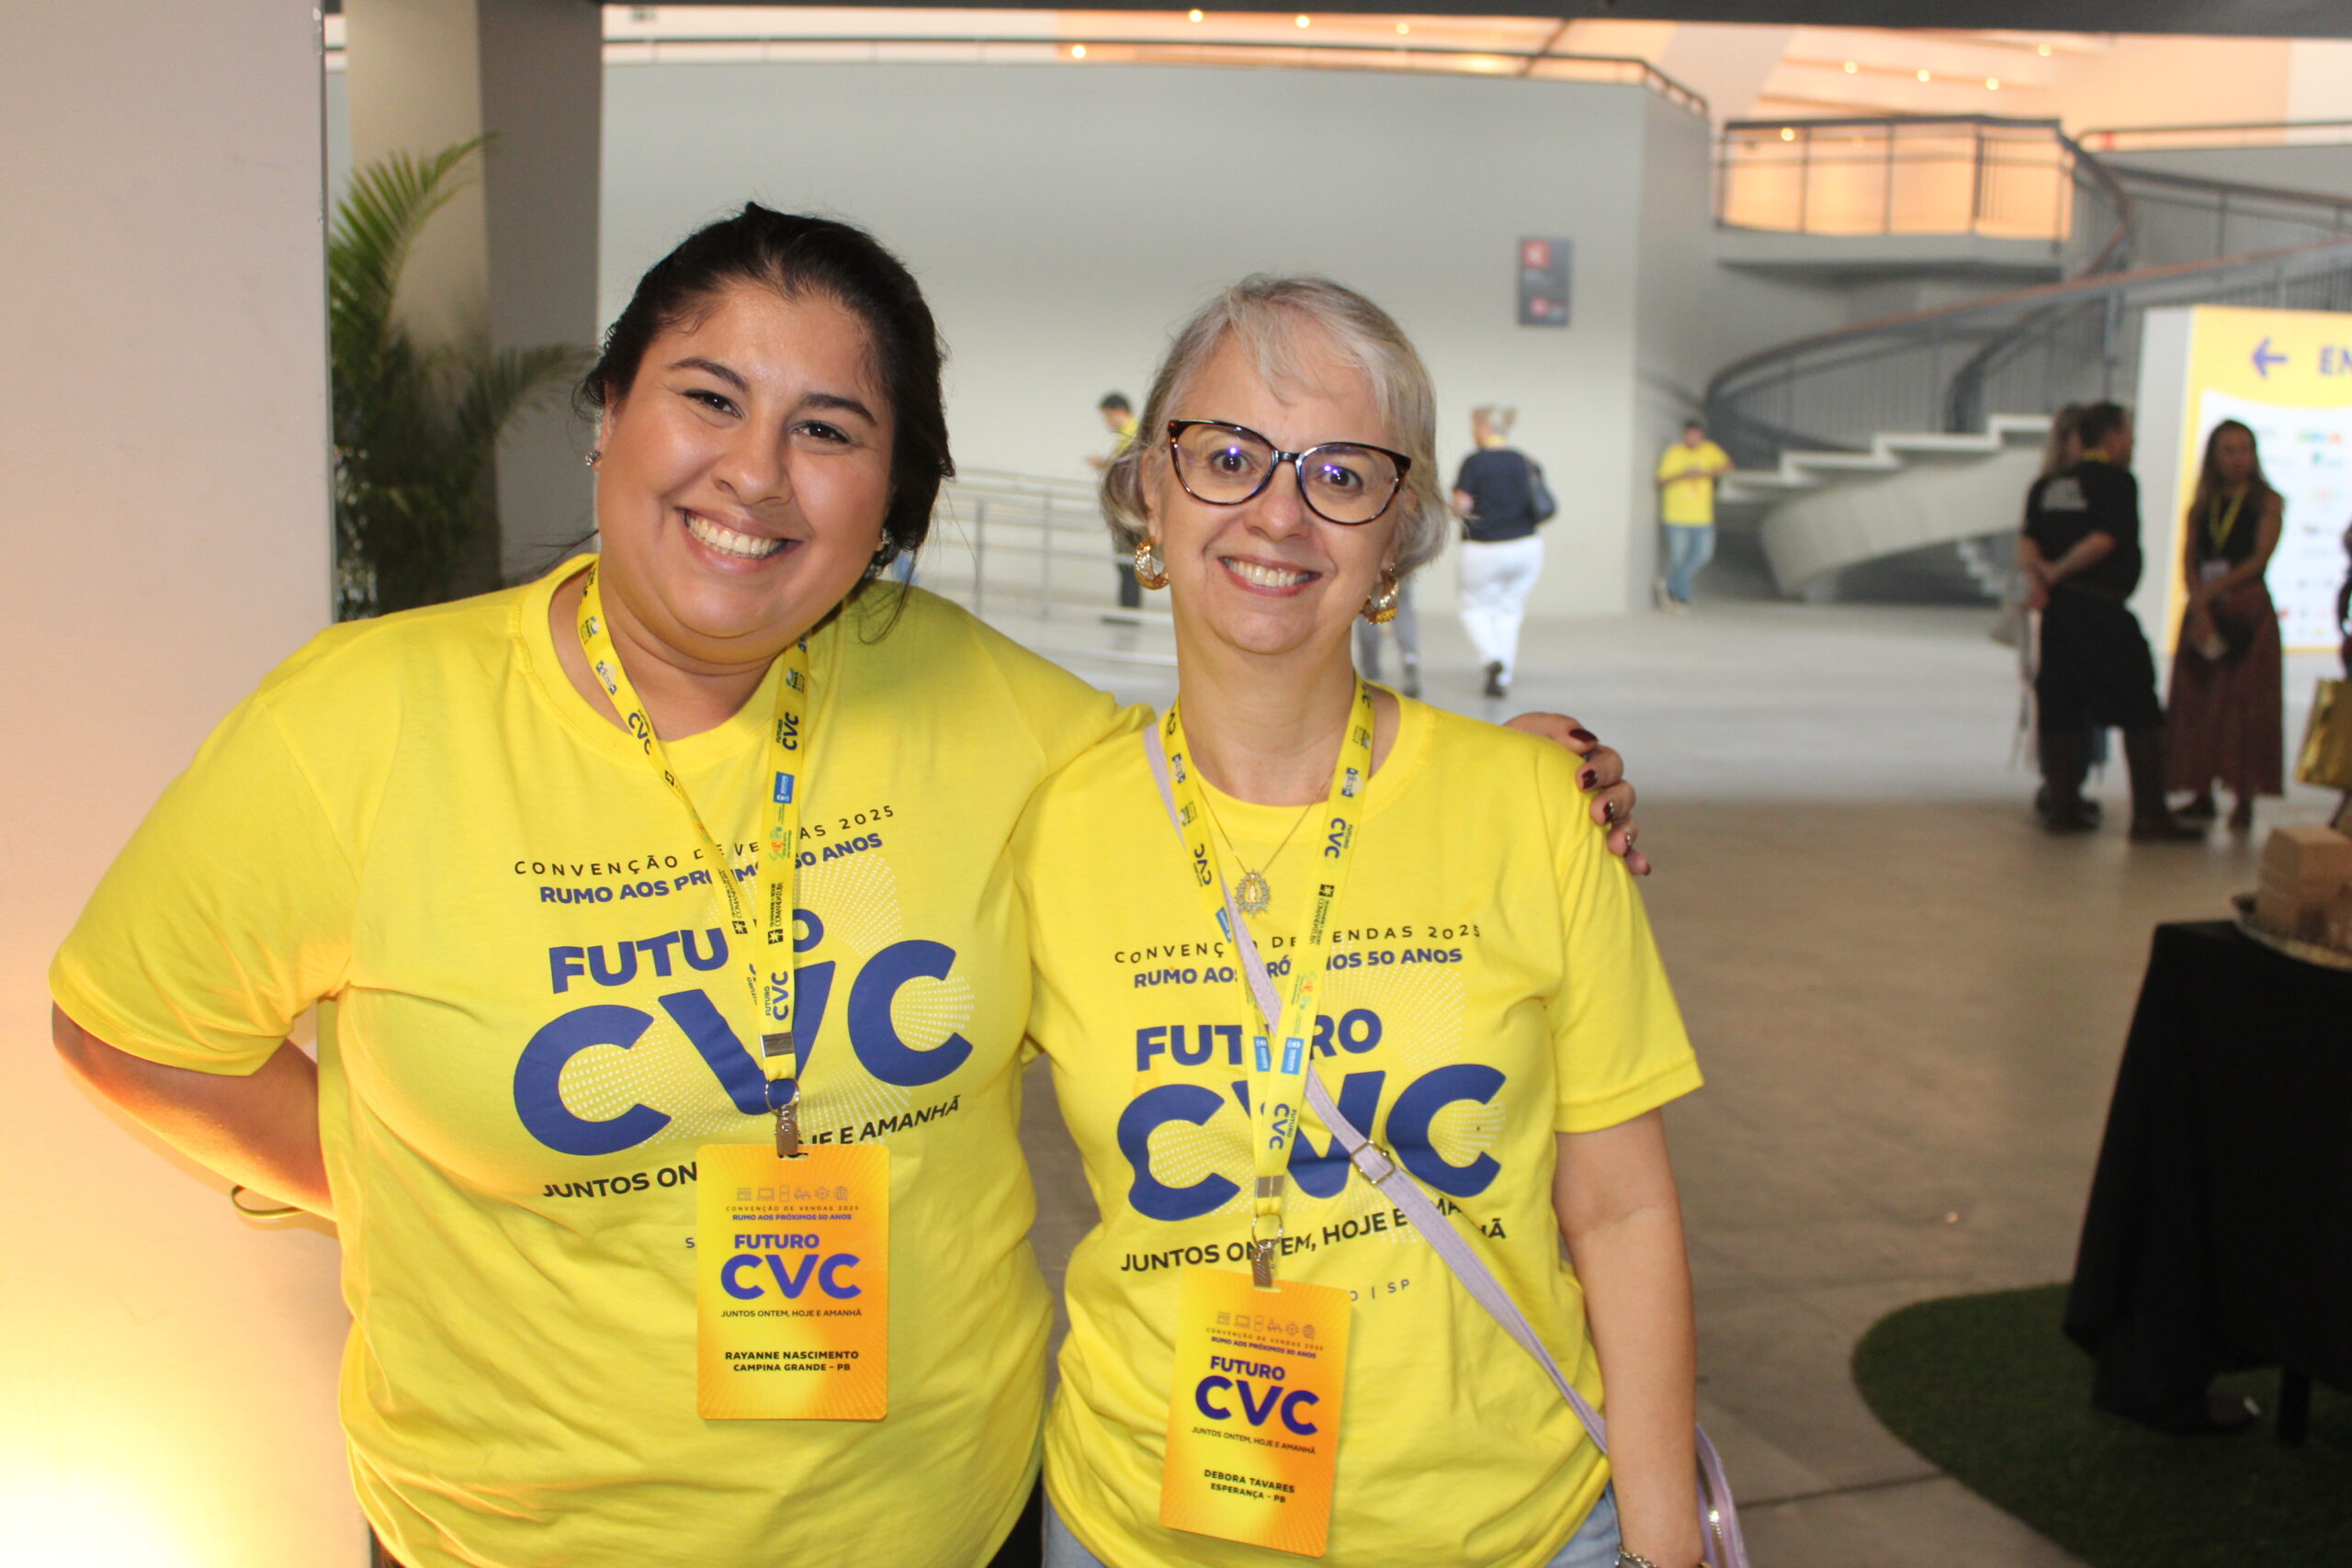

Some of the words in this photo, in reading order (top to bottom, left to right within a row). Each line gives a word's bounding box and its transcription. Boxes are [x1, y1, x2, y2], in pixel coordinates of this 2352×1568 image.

[628, 712, 651, 756] CVC
[782, 711, 799, 750] CVC
[514, 855, 678, 876] CONVENÇÃO
[734, 825, 826, 856] VEAS
[839, 806, 894, 829] 2025
[1324, 818, 1347, 859] CVC
[540, 886, 613, 904] RUMO
[619, 881, 670, 899] AOS
[822, 833, 883, 862] ANOS
[1194, 843, 1212, 886] CVC
[548, 908, 824, 994] FUTUO
[1114, 940, 1259, 964] CONVENÇ
[1272, 936, 1296, 948] DE
[1332, 926, 1413, 943] ENDAS
[1428, 924, 1480, 940] 2025
[1134, 968, 1198, 988] RUMO
[1367, 951, 1395, 965] 50
[1400, 948, 1463, 964] ANOS
[771, 970, 789, 1021] CVC
[513, 939, 974, 1156] CVC
[1136, 1009, 1383, 1072] FUTRO
[1117, 1063, 1507, 1222] CVC
[1270, 1103, 1290, 1150] CVC
[1286, 1109, 1297, 1138] FUTURO
[543, 1172, 650, 1198] JUNTOS
[839, 1126, 854, 1145] E
[858, 1094, 961, 1143] AMANHÃ
[726, 1204, 779, 1213] CONVENÇÃO
[734, 1234, 820, 1249] FUTURO
[1121, 1243, 1220, 1272] JUNTOS
[1322, 1213, 1387, 1246] HOJE
[1393, 1208, 1408, 1227] E
[720, 1253, 862, 1300] CVC
[1387, 1279, 1410, 1293] SP
[725, 1351, 780, 1359] RAYANNE
[783, 1351, 859, 1359] NASCIMENTO
[1210, 1356, 1285, 1382] FUTURO
[1211, 1337, 1232, 1345] RUMO
[1296, 1350, 1317, 1359] ANOS
[1195, 1375, 1320, 1436] CVC
[1192, 1427, 1222, 1438] JUNTOS
[1223, 1432, 1252, 1445] ONTEM,
[1253, 1438, 1273, 1448] HOJE
[1281, 1442, 1316, 1454] AMANHÃ
[1204, 1469, 1246, 1483] DEBORA
[1250, 1477, 1295, 1494] TAVARES
[1211, 1483, 1264, 1500] ESPERANÇA
[1273, 1495, 1285, 1503] PB
